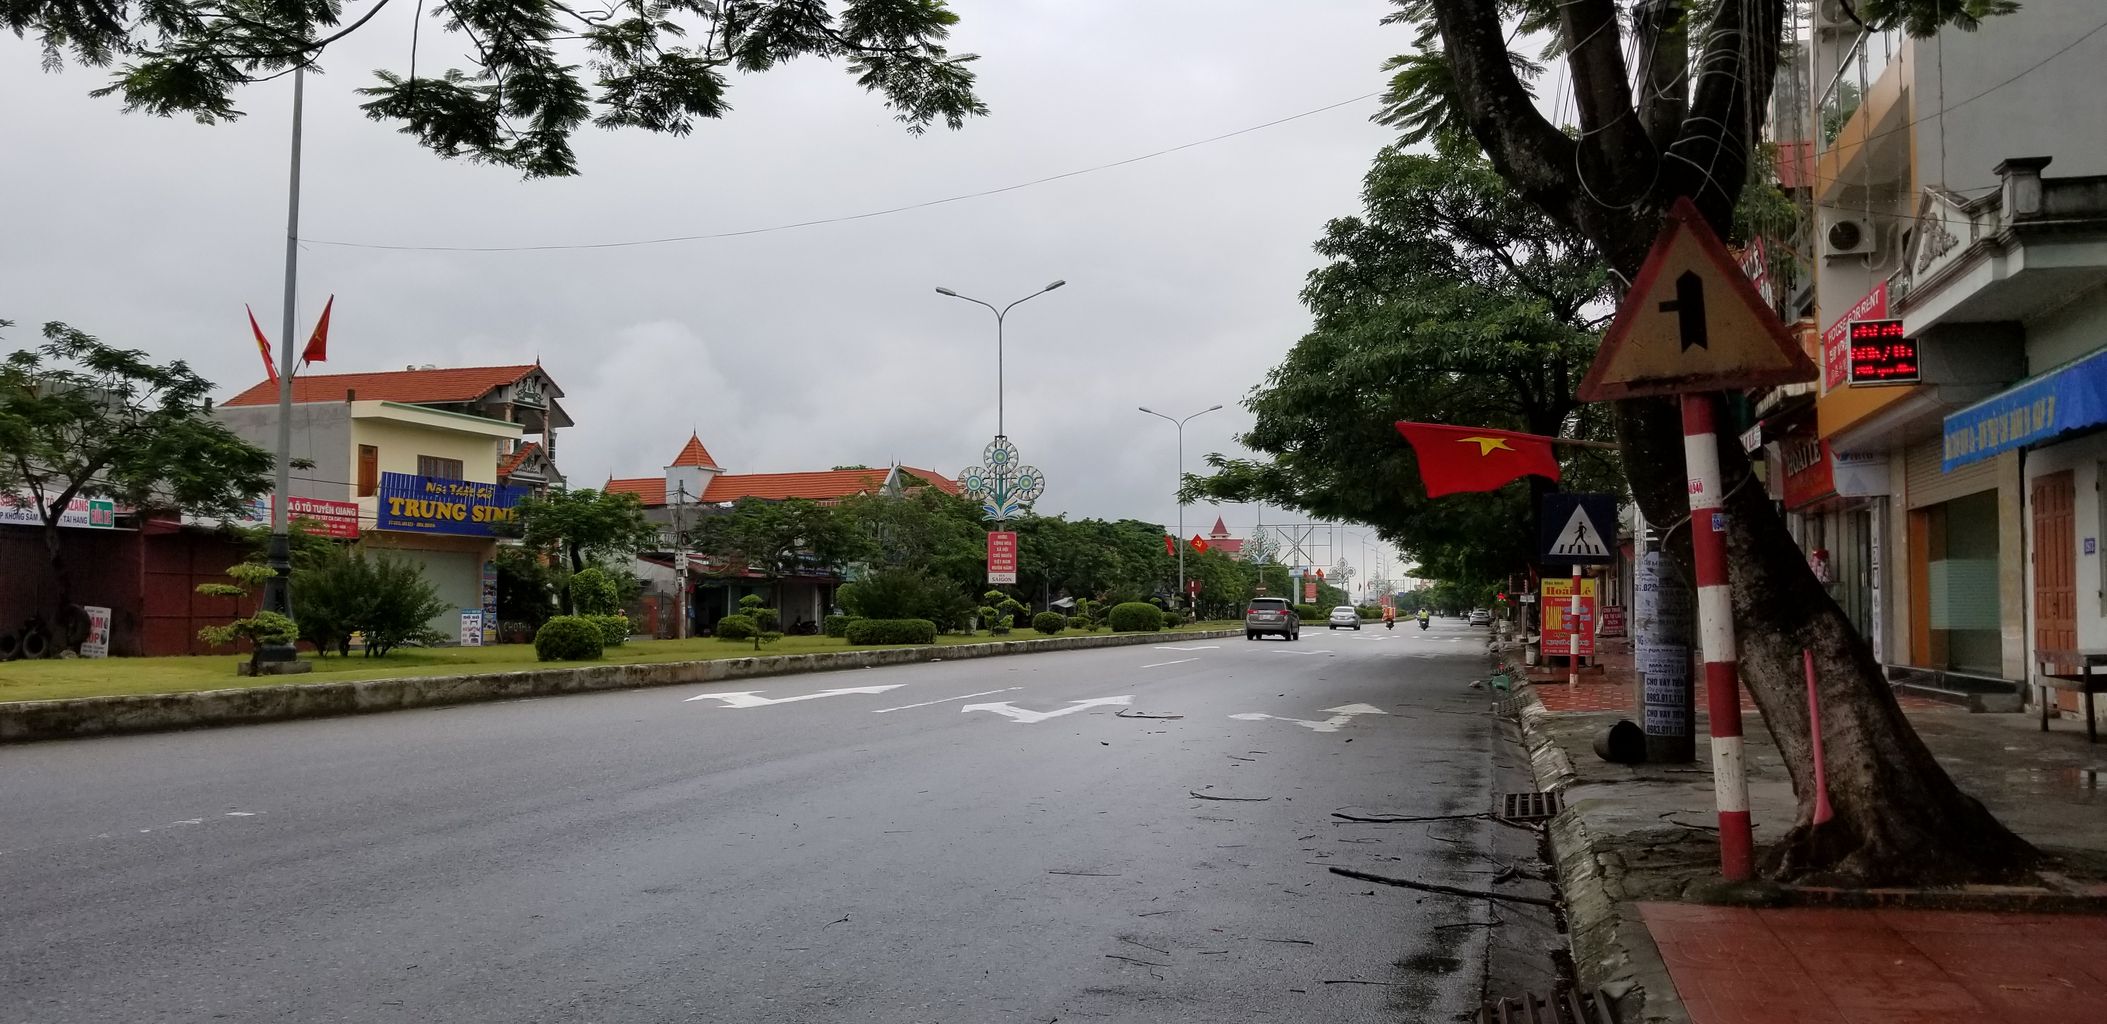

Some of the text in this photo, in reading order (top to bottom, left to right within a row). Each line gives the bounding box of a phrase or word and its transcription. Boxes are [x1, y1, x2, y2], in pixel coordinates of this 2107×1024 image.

[1827, 316, 1847, 343] HOUSE
[1847, 307, 1861, 322] FOR
[1861, 290, 1880, 314] RENT
[302, 502, 312, 512] TÔ
[335, 506, 356, 516] GIANG
[388, 496, 467, 521] TRUNG
